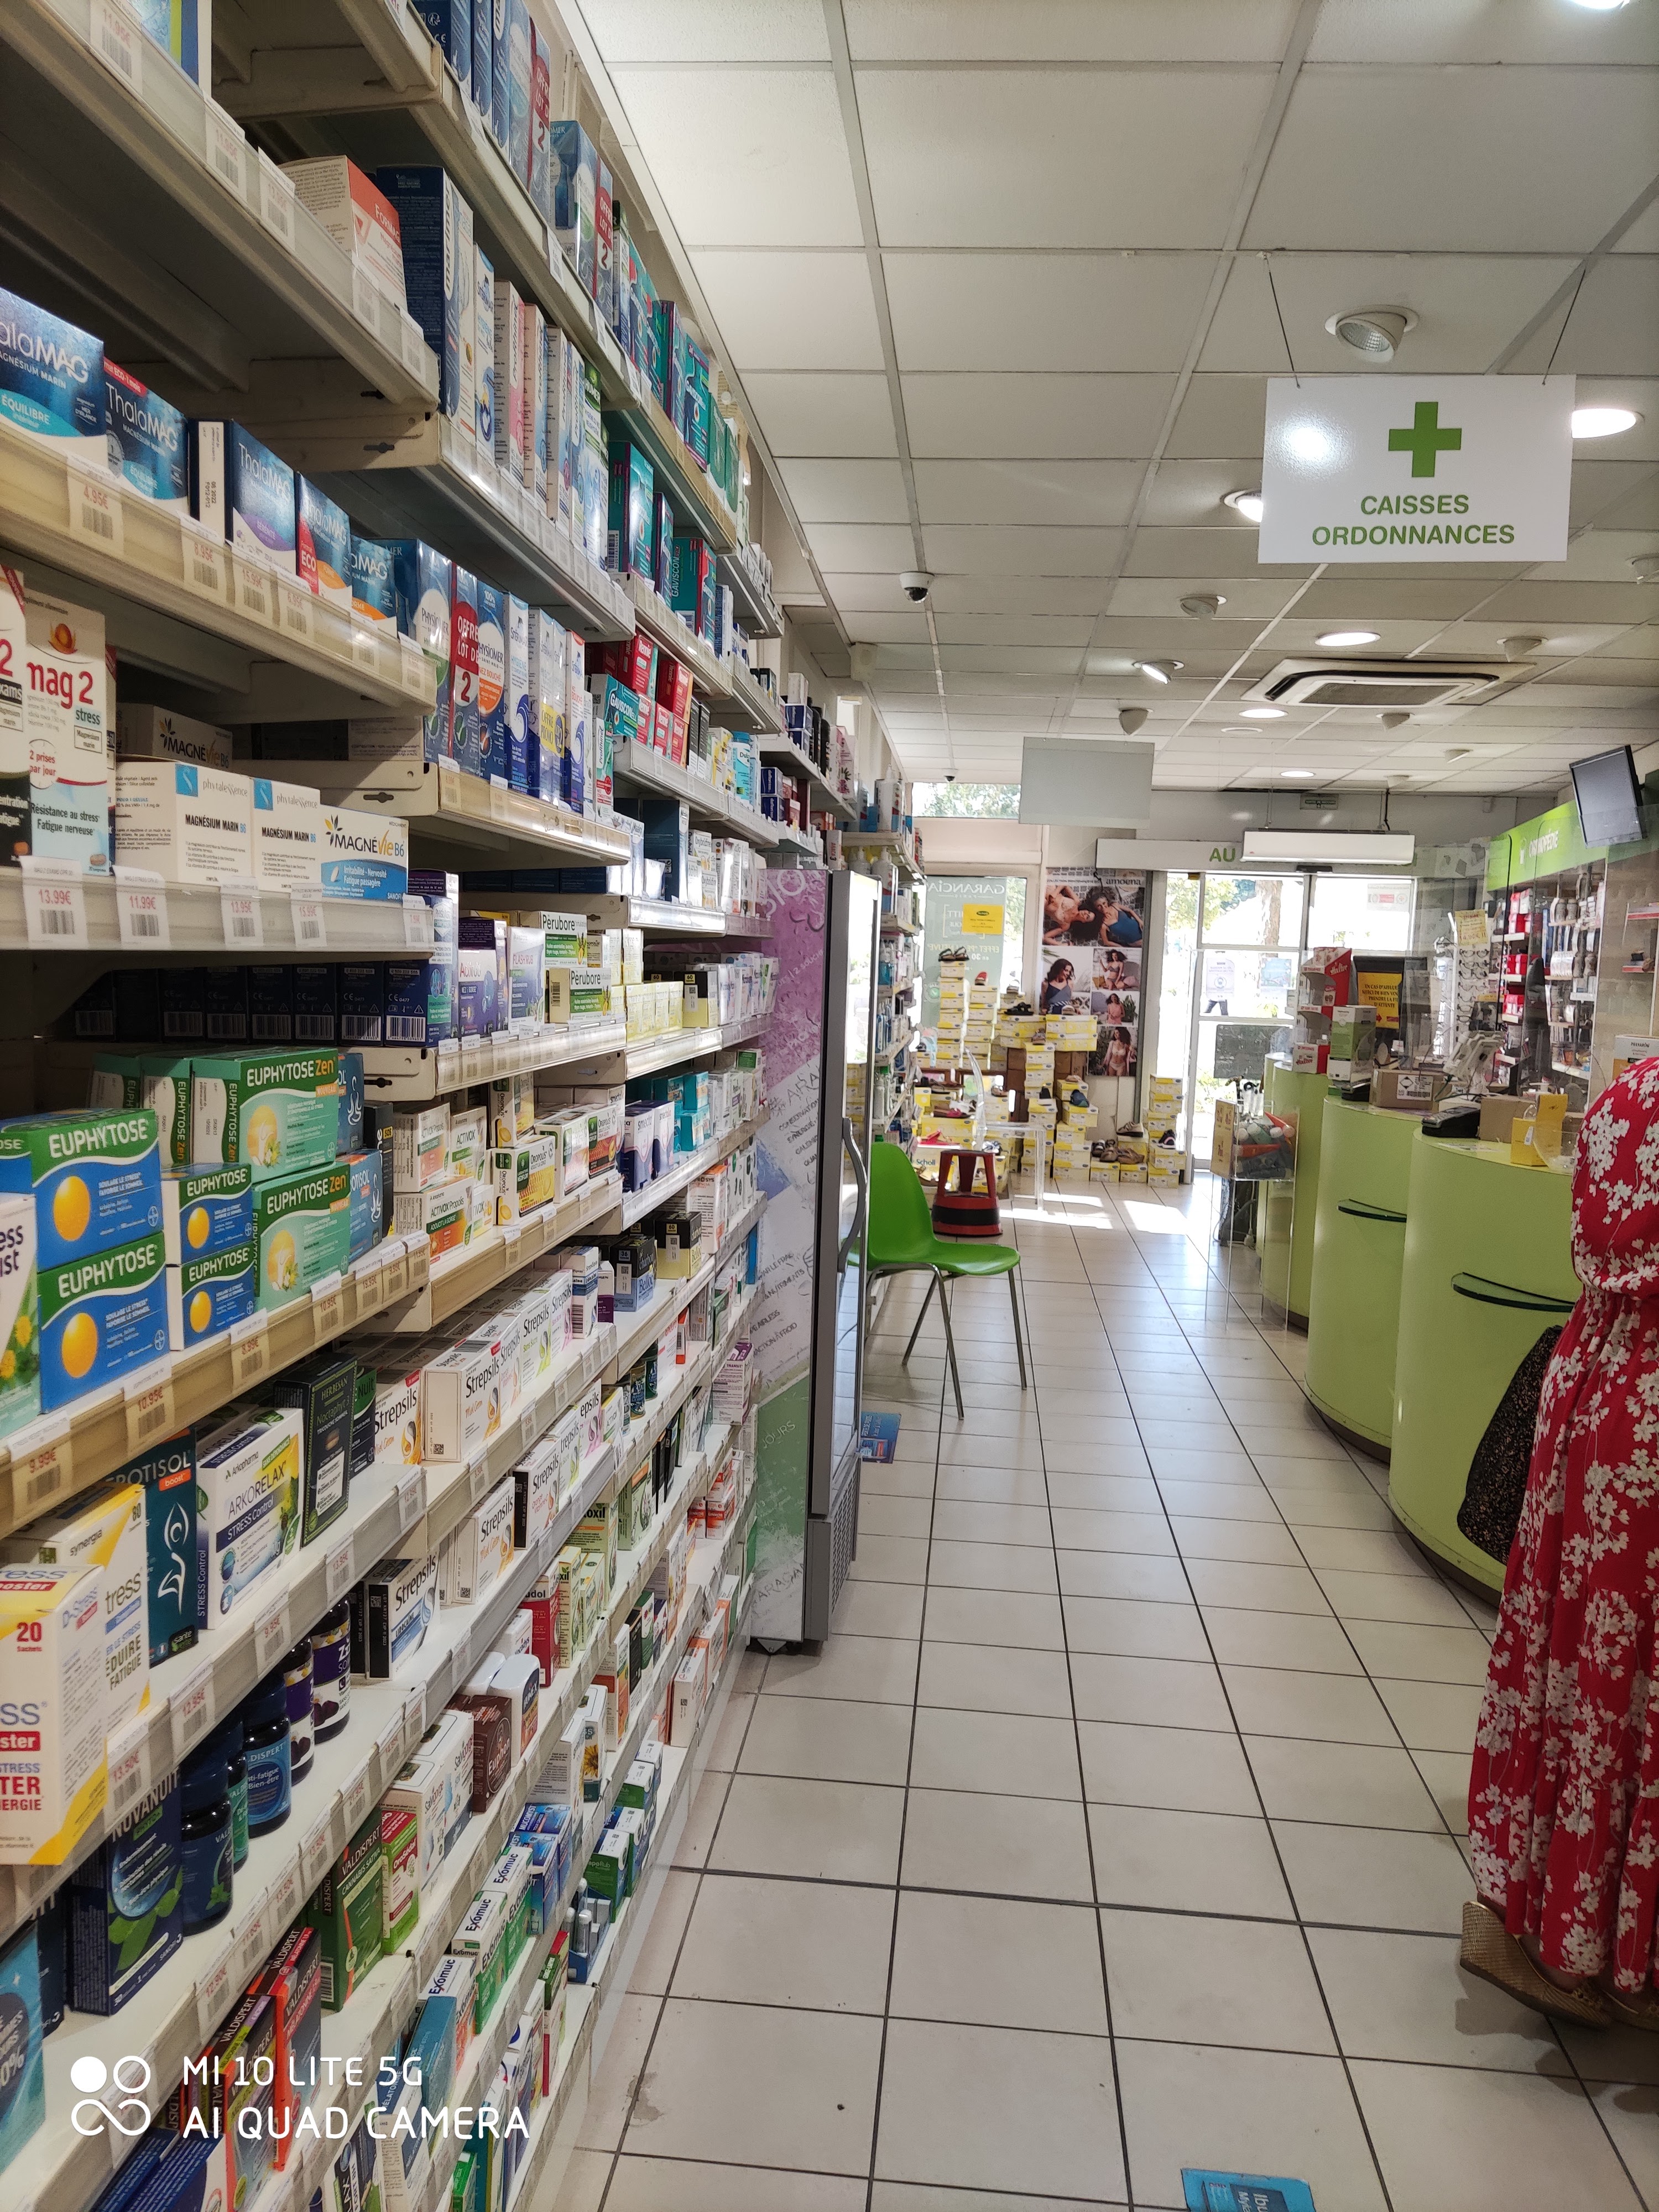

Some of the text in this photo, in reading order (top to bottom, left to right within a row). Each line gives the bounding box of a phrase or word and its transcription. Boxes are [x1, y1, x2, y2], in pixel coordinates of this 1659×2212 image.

[374, 203, 401, 243] FORMAG
[40, 368, 67, 389] MARIN
[585, 380, 601, 405] HUMER
[1, 396, 50, 425] ÉQUILIBRE
[106, 382, 178, 452] ThalaMAG
[238, 442, 291, 503] ThalaMAG
[84, 486, 108, 509] 4.95€
[1360, 494, 1469, 515] CAISSES
[1312, 524, 1515, 545] ORDONNANCES
[301, 553, 316, 572] ECO
[458, 615, 478, 643] OFFRE
[457, 640, 469, 660] LOT
[79, 671, 93, 705] 2
[461, 671, 471, 703] 2
[76, 708, 101, 725] stress
[610, 692, 632, 719] GAVISCON
[541, 713, 553, 728] OFFRE
[29, 750, 55, 764] 2 prises
[29, 765, 56, 777] par jour
[31, 803, 100, 823] Résistance au stress
[185, 814, 221, 830] MAGNÉSIUM
[222, 820, 238, 832] MARIN
[37, 819, 95, 836] Fatigue nerveuse
[262, 827, 293, 841] MAGNÉSIUM
[294, 831, 309, 842] MARIN
[394, 843, 404, 857] B6
[1209, 847, 1235, 863] AU
[344, 876, 381, 889] Fatigue passagère
[367, 868, 387, 878] Nervosité
[1105, 877, 1142, 886] amoena
[39, 889, 71, 906] 13.99€
[129, 895, 156, 910] 11.99€
[247, 1057, 336, 1087] EUPHYTOSE Zen
[178, 1081, 186, 1141] EUPHYTOSE
[229, 1083, 238, 1144] EUPHYTOSE
[638, 1115, 652, 1131] smecta
[49, 1118, 149, 1159] EUPHYTOSE
[457, 1129, 476, 1146] ACTIVOX
[187, 1168, 248, 1197] EUPHYTOSE
[267, 1172, 347, 1214] EUPHYTOSE Zen
[431, 1196, 464, 1217] ACTIVOX Propolis
[58, 1244, 157, 1298] EUPHYTOSE
[189, 1246, 250, 1282] EUPHYTOSE
[552, 1283, 571, 1313] Strepsils
[523, 1307, 550, 1338] Strepsils
[500, 1328, 520, 1366] Strepsils
[321, 1376, 348, 1401] HERBESAN
[466, 1355, 499, 1398] Strepsils
[137, 1386, 163, 1411] 10.95€
[374, 1387, 418, 1435] Strepsils
[580, 1392, 599, 1417] epsils
[763, 1421, 796, 1449] JOURS
[232, 1452, 259, 1477] Arkopharma
[533, 1452, 559, 1495] Strepsils
[165, 1473, 184, 1488] boost
[228, 1461, 285, 1520] ARKORELAX
[132, 1502, 142, 1522] 80
[228, 1496, 274, 1540] STRESS Control
[481, 1495, 513, 1543] Strepsils
[70, 1529, 102, 1557] synergia
[395, 1554, 437, 1611] Strepsils
[17, 1623, 41, 1642] 20
[395, 1611, 414, 1637] LIDOCAÏNE
[109, 1652, 142, 1691] FATIGUE
[523, 1682, 538, 1710] HUMEX
[488, 1738, 510, 1776] Euphon
[519, 1805, 536, 1830] MUCOMYST
[341, 1825, 382, 1876] VALDISPERT
[341, 1869, 362, 1896] CANNABIS
[493, 1853, 518, 1884] Exomuc
[508, 1876, 532, 1922] Exomuc
[466, 1898, 491, 1932] Exomuc
[270, 1931, 300, 1970] VALDISPERT
[453, 1948, 478, 1957] Exomuc
[482, 1918, 506, 1971] Exomuc
[285, 1952, 320, 2017] VALDISPERT
[429, 1959, 455, 1995] Exomuc
[220, 1998, 256, 2043] VALDISPERT
